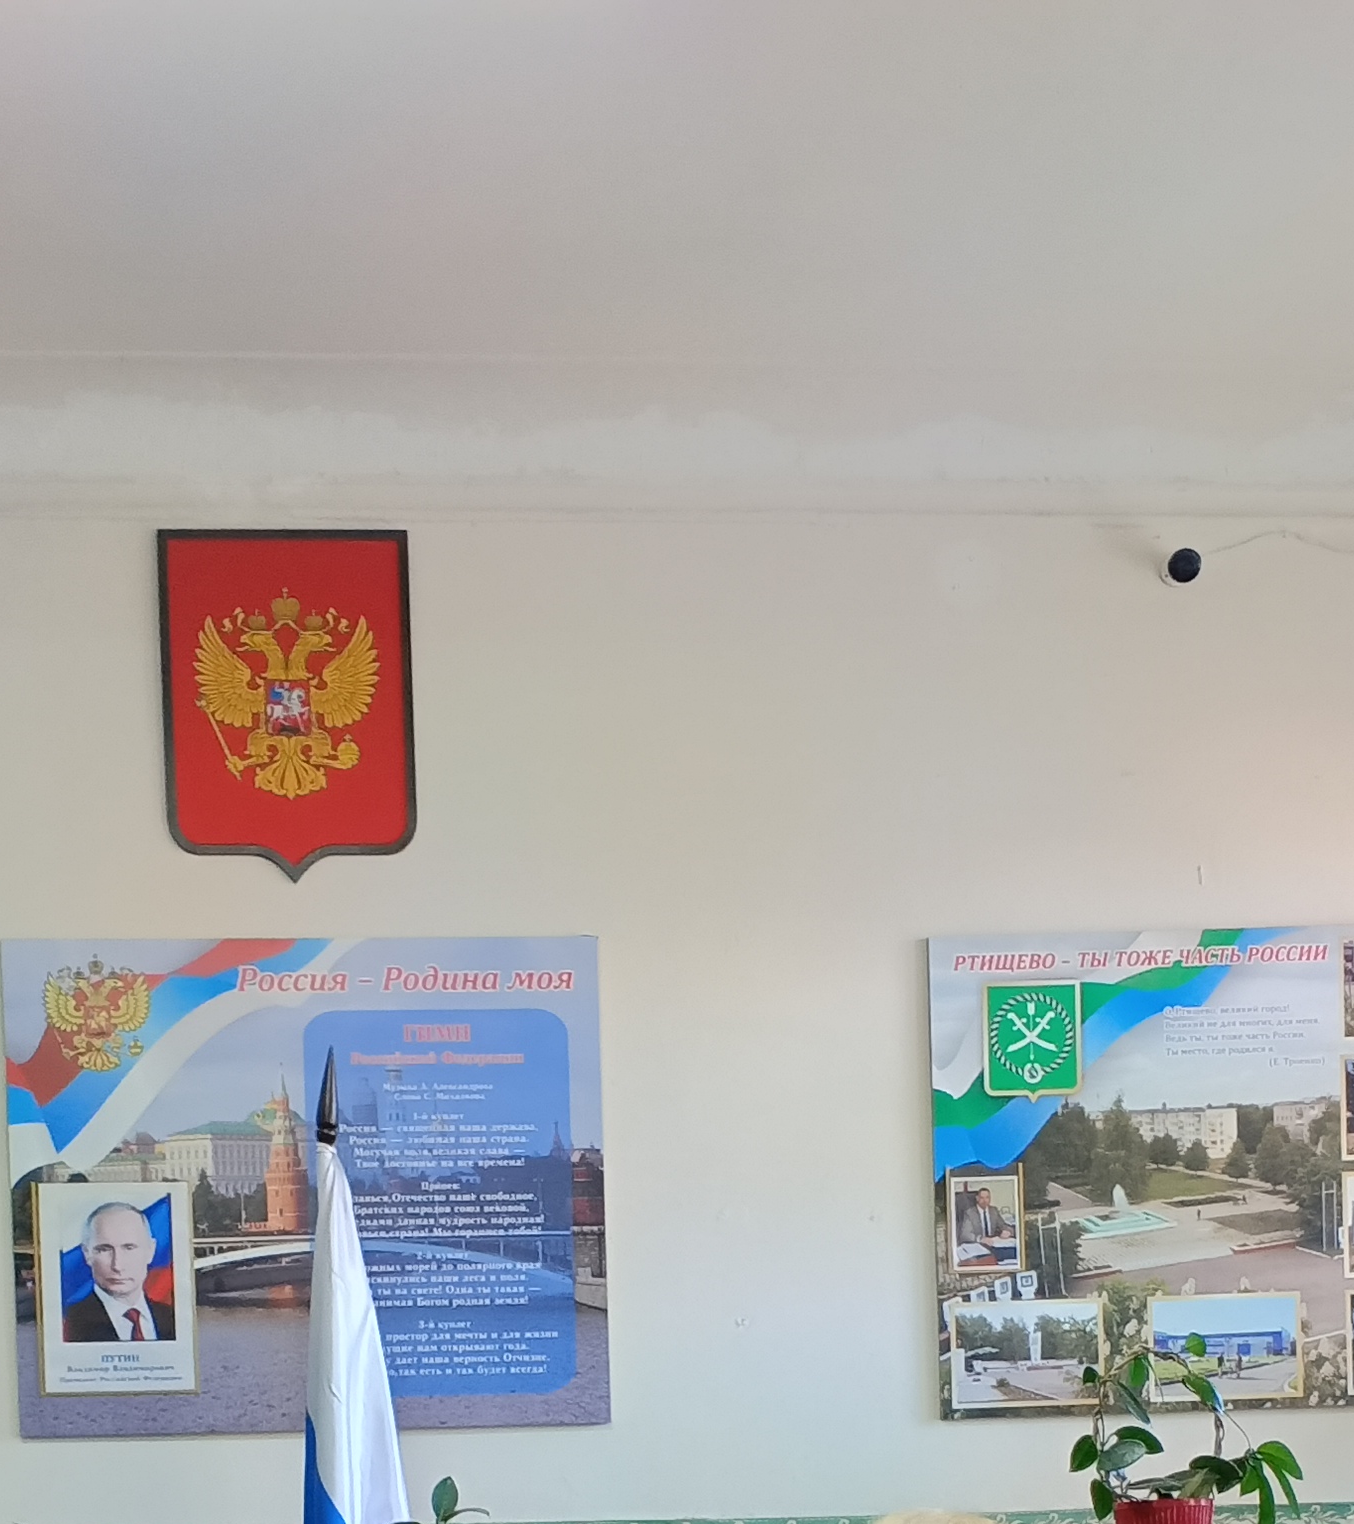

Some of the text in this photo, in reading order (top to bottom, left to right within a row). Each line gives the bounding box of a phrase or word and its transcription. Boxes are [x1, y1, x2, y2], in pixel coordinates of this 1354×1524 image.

[954, 953, 1056, 973] РТИЩЕВО
[1078, 952, 1108, 969] ТЫ
[1116, 949, 1172, 967] ТОЖЕ
[1179, 947, 1241, 965] ЧАСТЬ
[1247, 944, 1328, 963] РОССИИ
[238, 966, 348, 992] Россия
[381, 964, 499, 993] Родина
[507, 970, 574, 991] моя
[1261, 1004, 1290, 1015] город!
[1165, 1020, 1205, 1029] Великий
[1207, 1020, 1217, 1028] не
[1220, 1020, 1237, 1029] для
[1276, 1019, 1293, 1027] для
[403, 1023, 471, 1043] ГИМН
[1165, 1034, 1187, 1044] Ведь
[1221, 1033, 1243, 1041] тоже
[1245, 1032, 1270, 1040] часть
[1166, 1047, 1179, 1056] Ты
[1211, 1047, 1226, 1056] где
[339, 1124, 378, 1133] Россия
[459, 1124, 487, 1132] наша
[349, 1136, 387, 1145] Россия
[459, 1136, 487, 1144] наша
[479, 1147, 509, 1156] слава
[440, 1159, 455, 1167] на
[457, 1159, 475, 1168] все
[478, 1157, 525, 1169] времена!
[449, 1193, 477, 1201] наше
[407, 1205, 451, 1215] народов
[454, 1204, 480, 1213] союз
[438, 1216, 488, 1227] мудрость
[404, 1262, 438, 1273] морей
[441, 1263, 454, 1271] до
[367, 1275, 427, 1286] скинулись
[430, 1274, 459, 1283] наши
[462, 1274, 486, 1282] леса
[377, 1285, 525, 1296] ты на свете! Одна ты такая
[416, 1296, 450, 1307] Богом
[452, 1297, 492, 1309] родная
[494, 1295, 529, 1305] земля!
[385, 1332, 429, 1343] простор
[431, 1332, 451, 1341] для
[454, 1332, 488, 1341] мечты
[500, 1332, 521, 1340] для
[524, 1330, 559, 1339] жизни
[416, 1344, 438, 1352] нам
[440, 1342, 500, 1353] открывают
[395, 1355, 418, 1364] дает
[421, 1355, 450, 1364] наша
[452, 1354, 500, 1366] верность
[419, 1367, 442, 1376] есть
[456, 1366, 474, 1375] так
[477, 1365, 507, 1377] будет
[510, 1364, 547, 1375] всегда!
